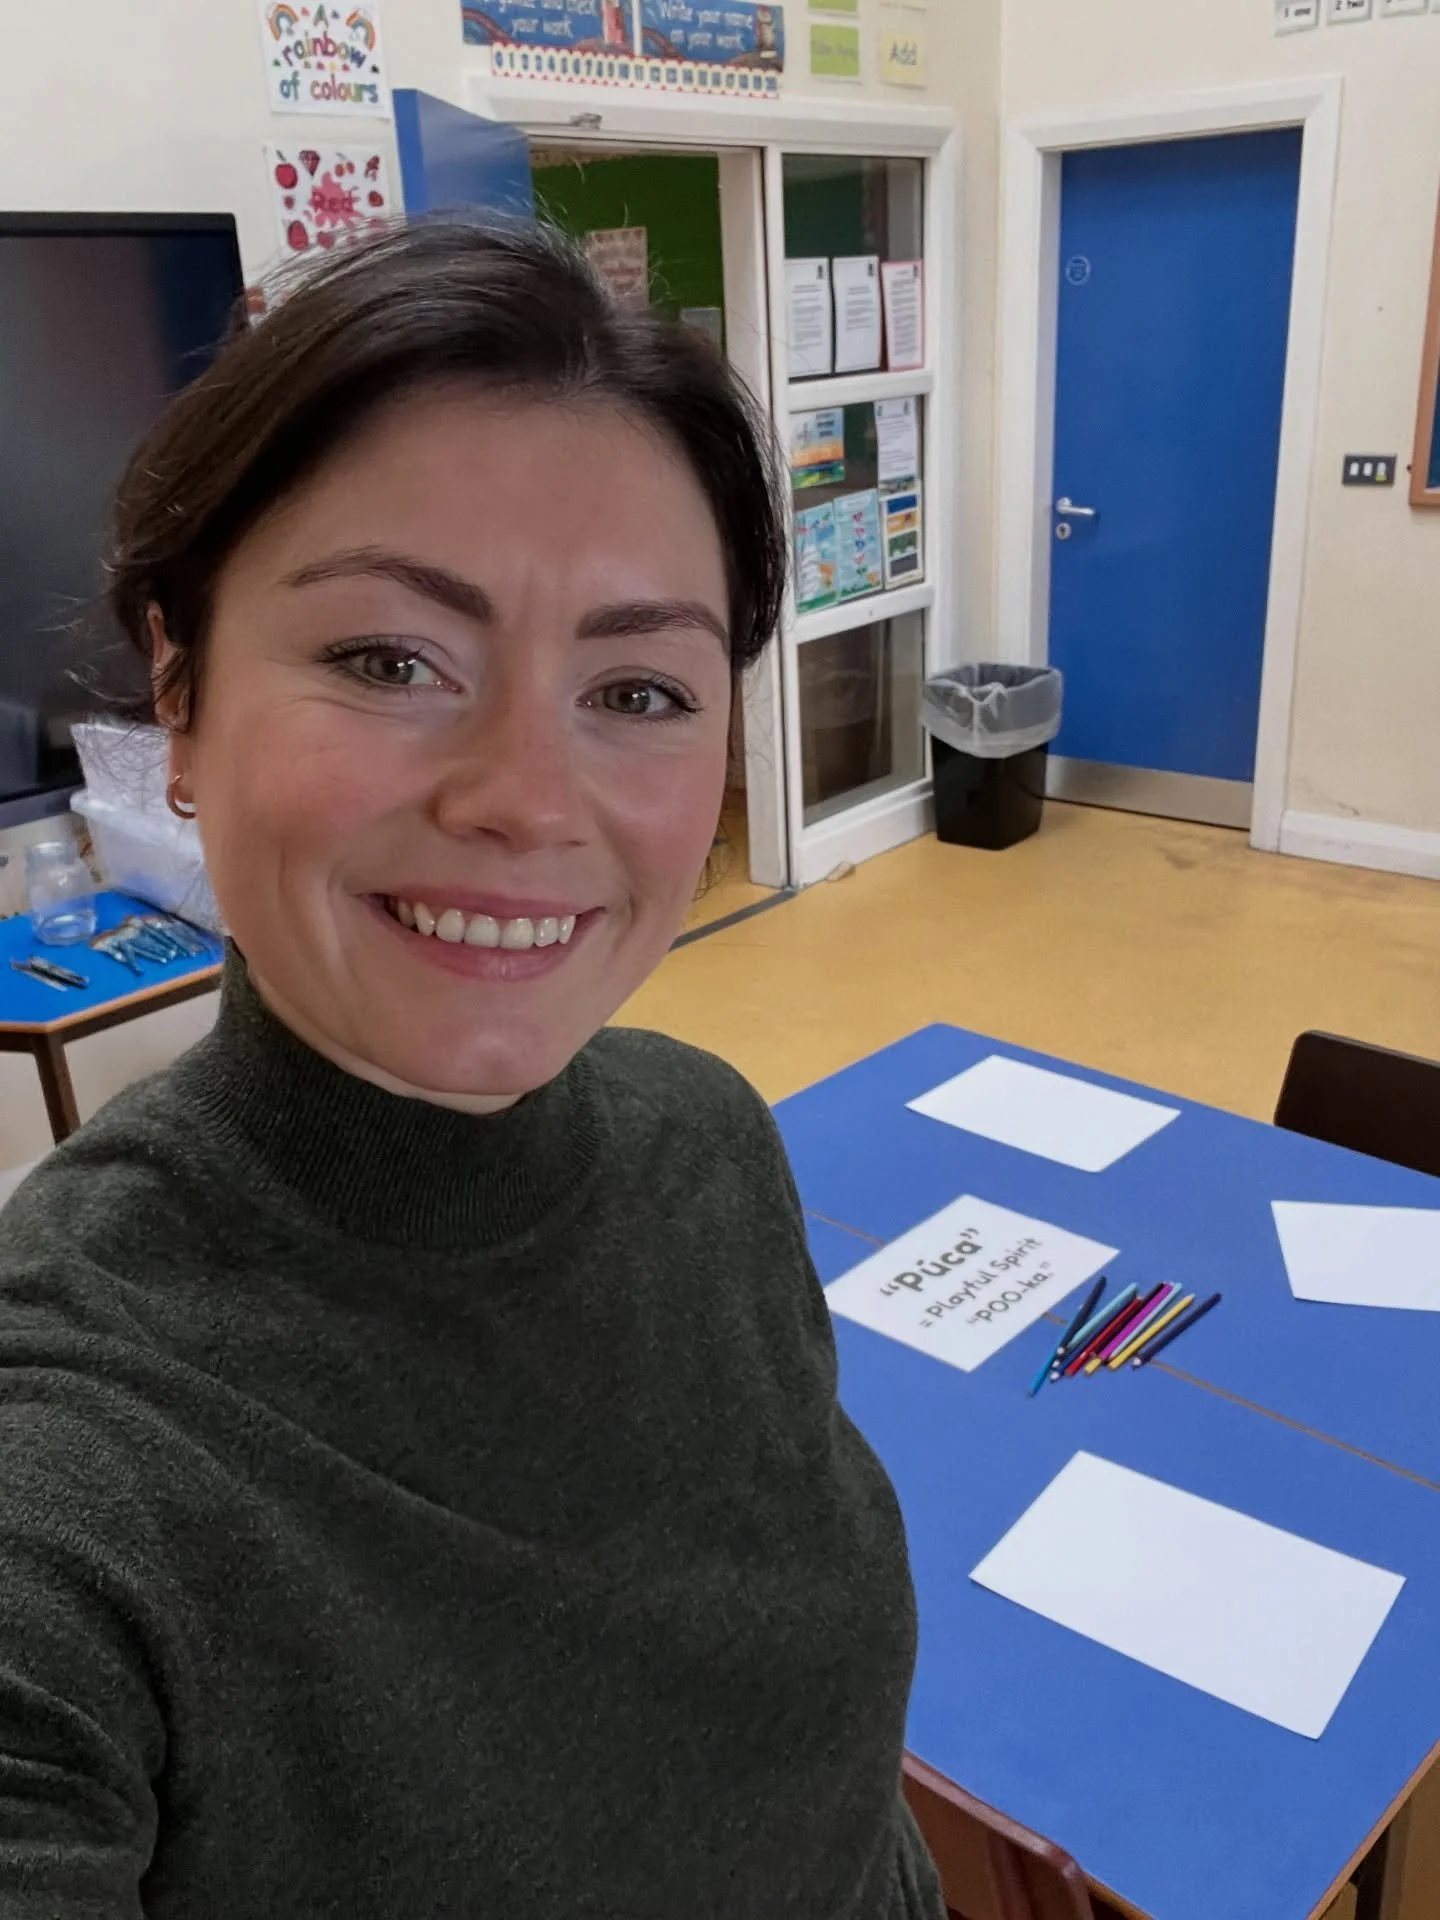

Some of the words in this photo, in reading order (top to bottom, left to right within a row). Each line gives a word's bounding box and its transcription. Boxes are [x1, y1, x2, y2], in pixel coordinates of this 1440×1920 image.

[313, 4, 328, 28] A
[282, 30, 367, 68] rainbow
[280, 70, 300, 101] of
[310, 72, 379, 103] colours
[310, 188, 353, 213] Red
[924, 1269, 999, 1319] Playful
[989, 1236, 1044, 1271] Spirit
